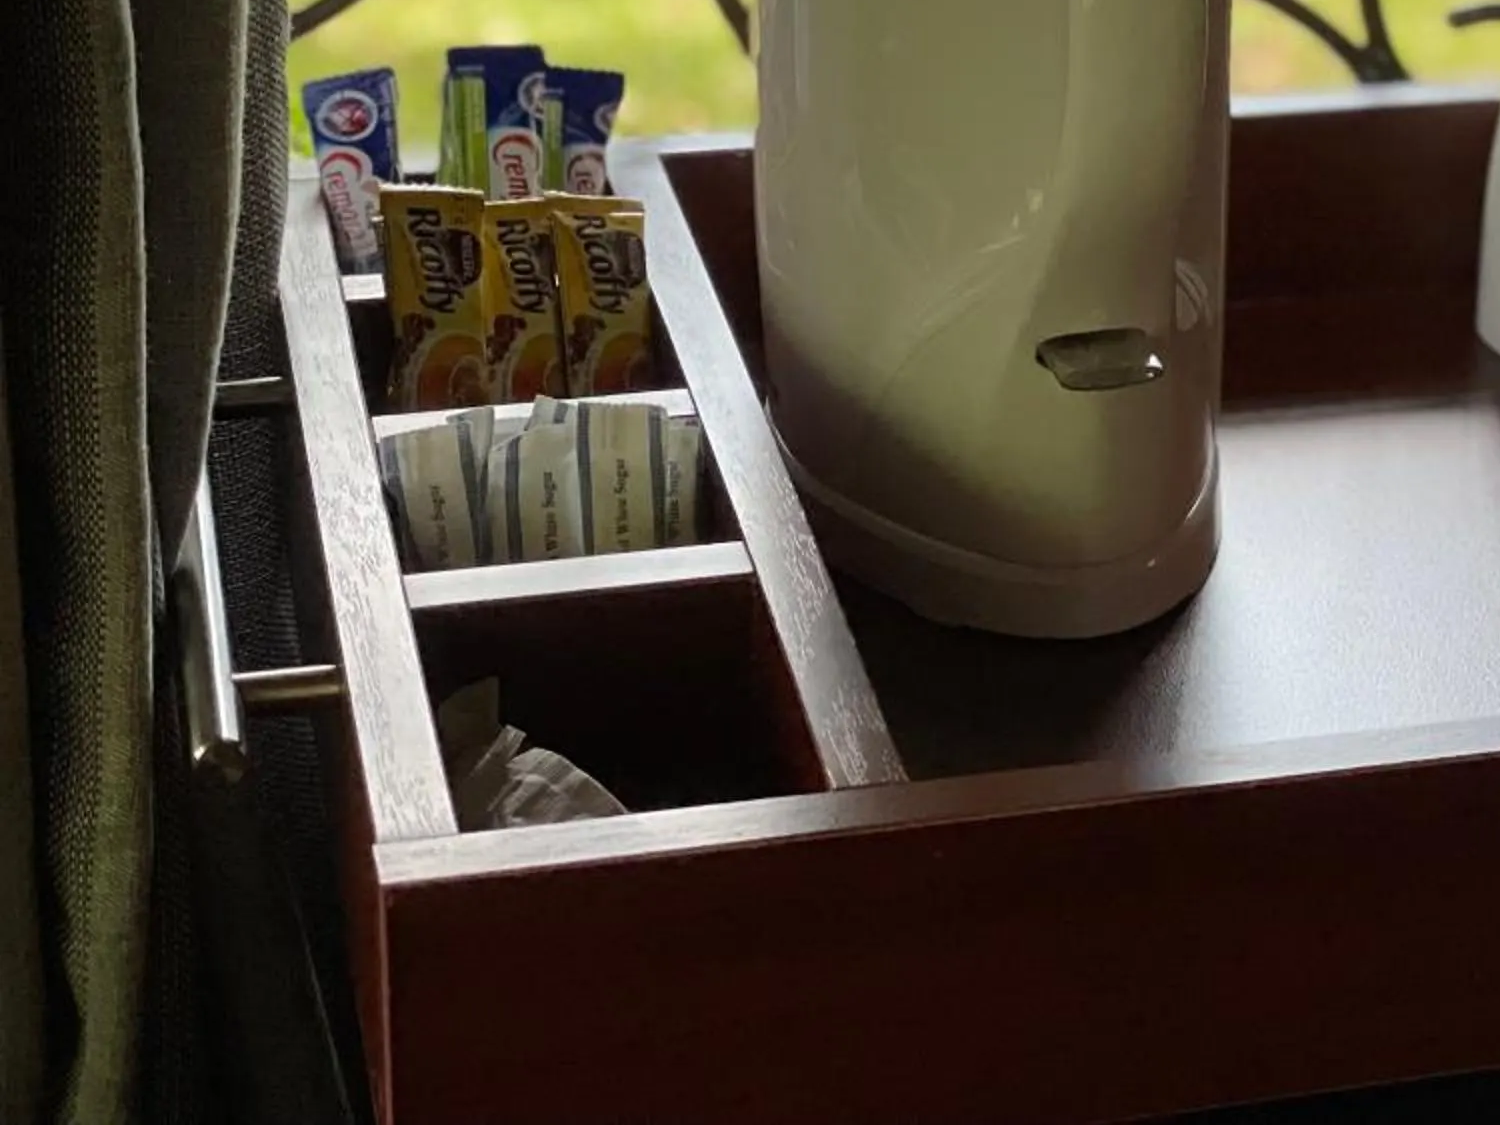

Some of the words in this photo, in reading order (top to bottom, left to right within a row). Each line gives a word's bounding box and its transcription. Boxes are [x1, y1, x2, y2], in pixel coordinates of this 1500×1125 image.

[494, 135, 540, 199] Crem
[407, 207, 464, 313] Ricoffy
[496, 218, 553, 313] Ricoffy
[574, 214, 630, 314] Ricoffy
